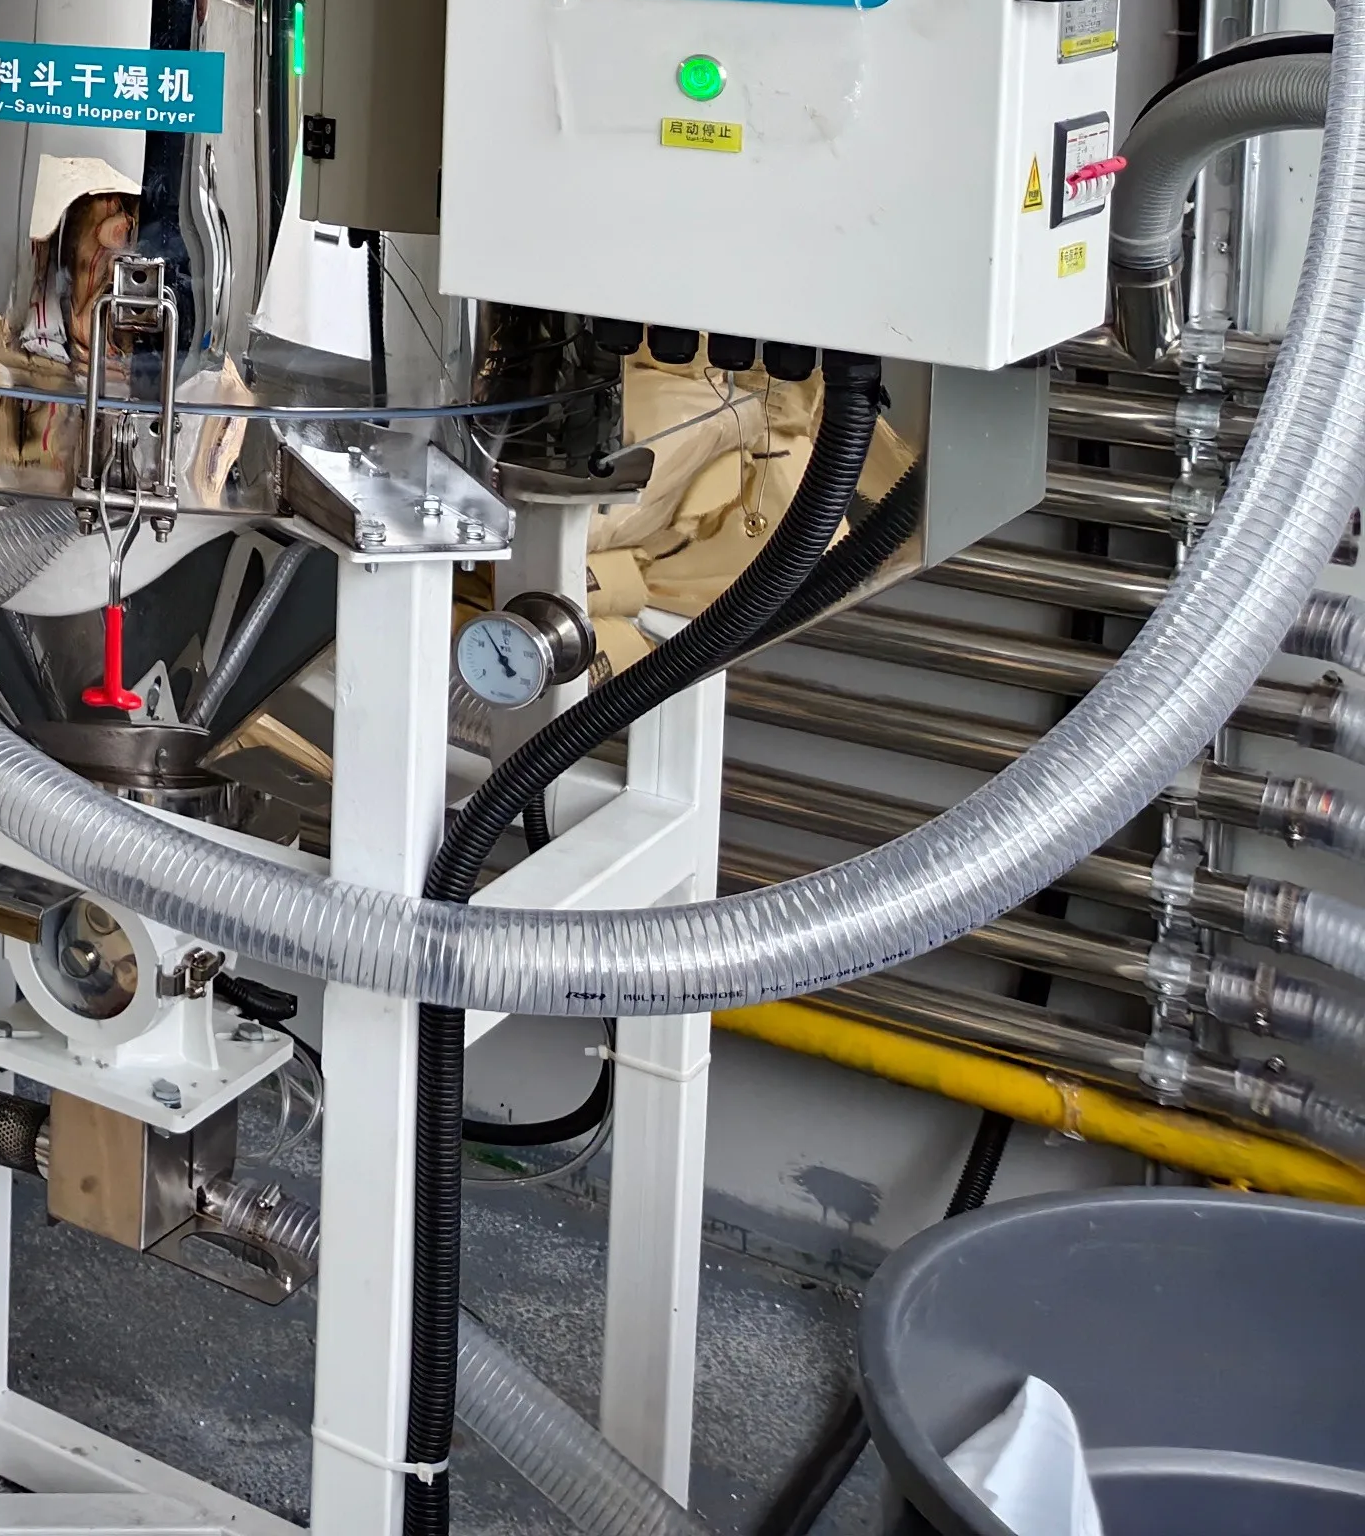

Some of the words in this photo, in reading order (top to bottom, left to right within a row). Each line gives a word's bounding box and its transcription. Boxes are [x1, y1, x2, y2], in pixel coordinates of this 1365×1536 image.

[77, 103, 142, 122] Hopper
[146, 107, 196, 125] Dryer
[669, 120, 732, 139] 启动停止
[623, 993, 666, 1002] MULTI
[761, 984, 787, 995] PVC
